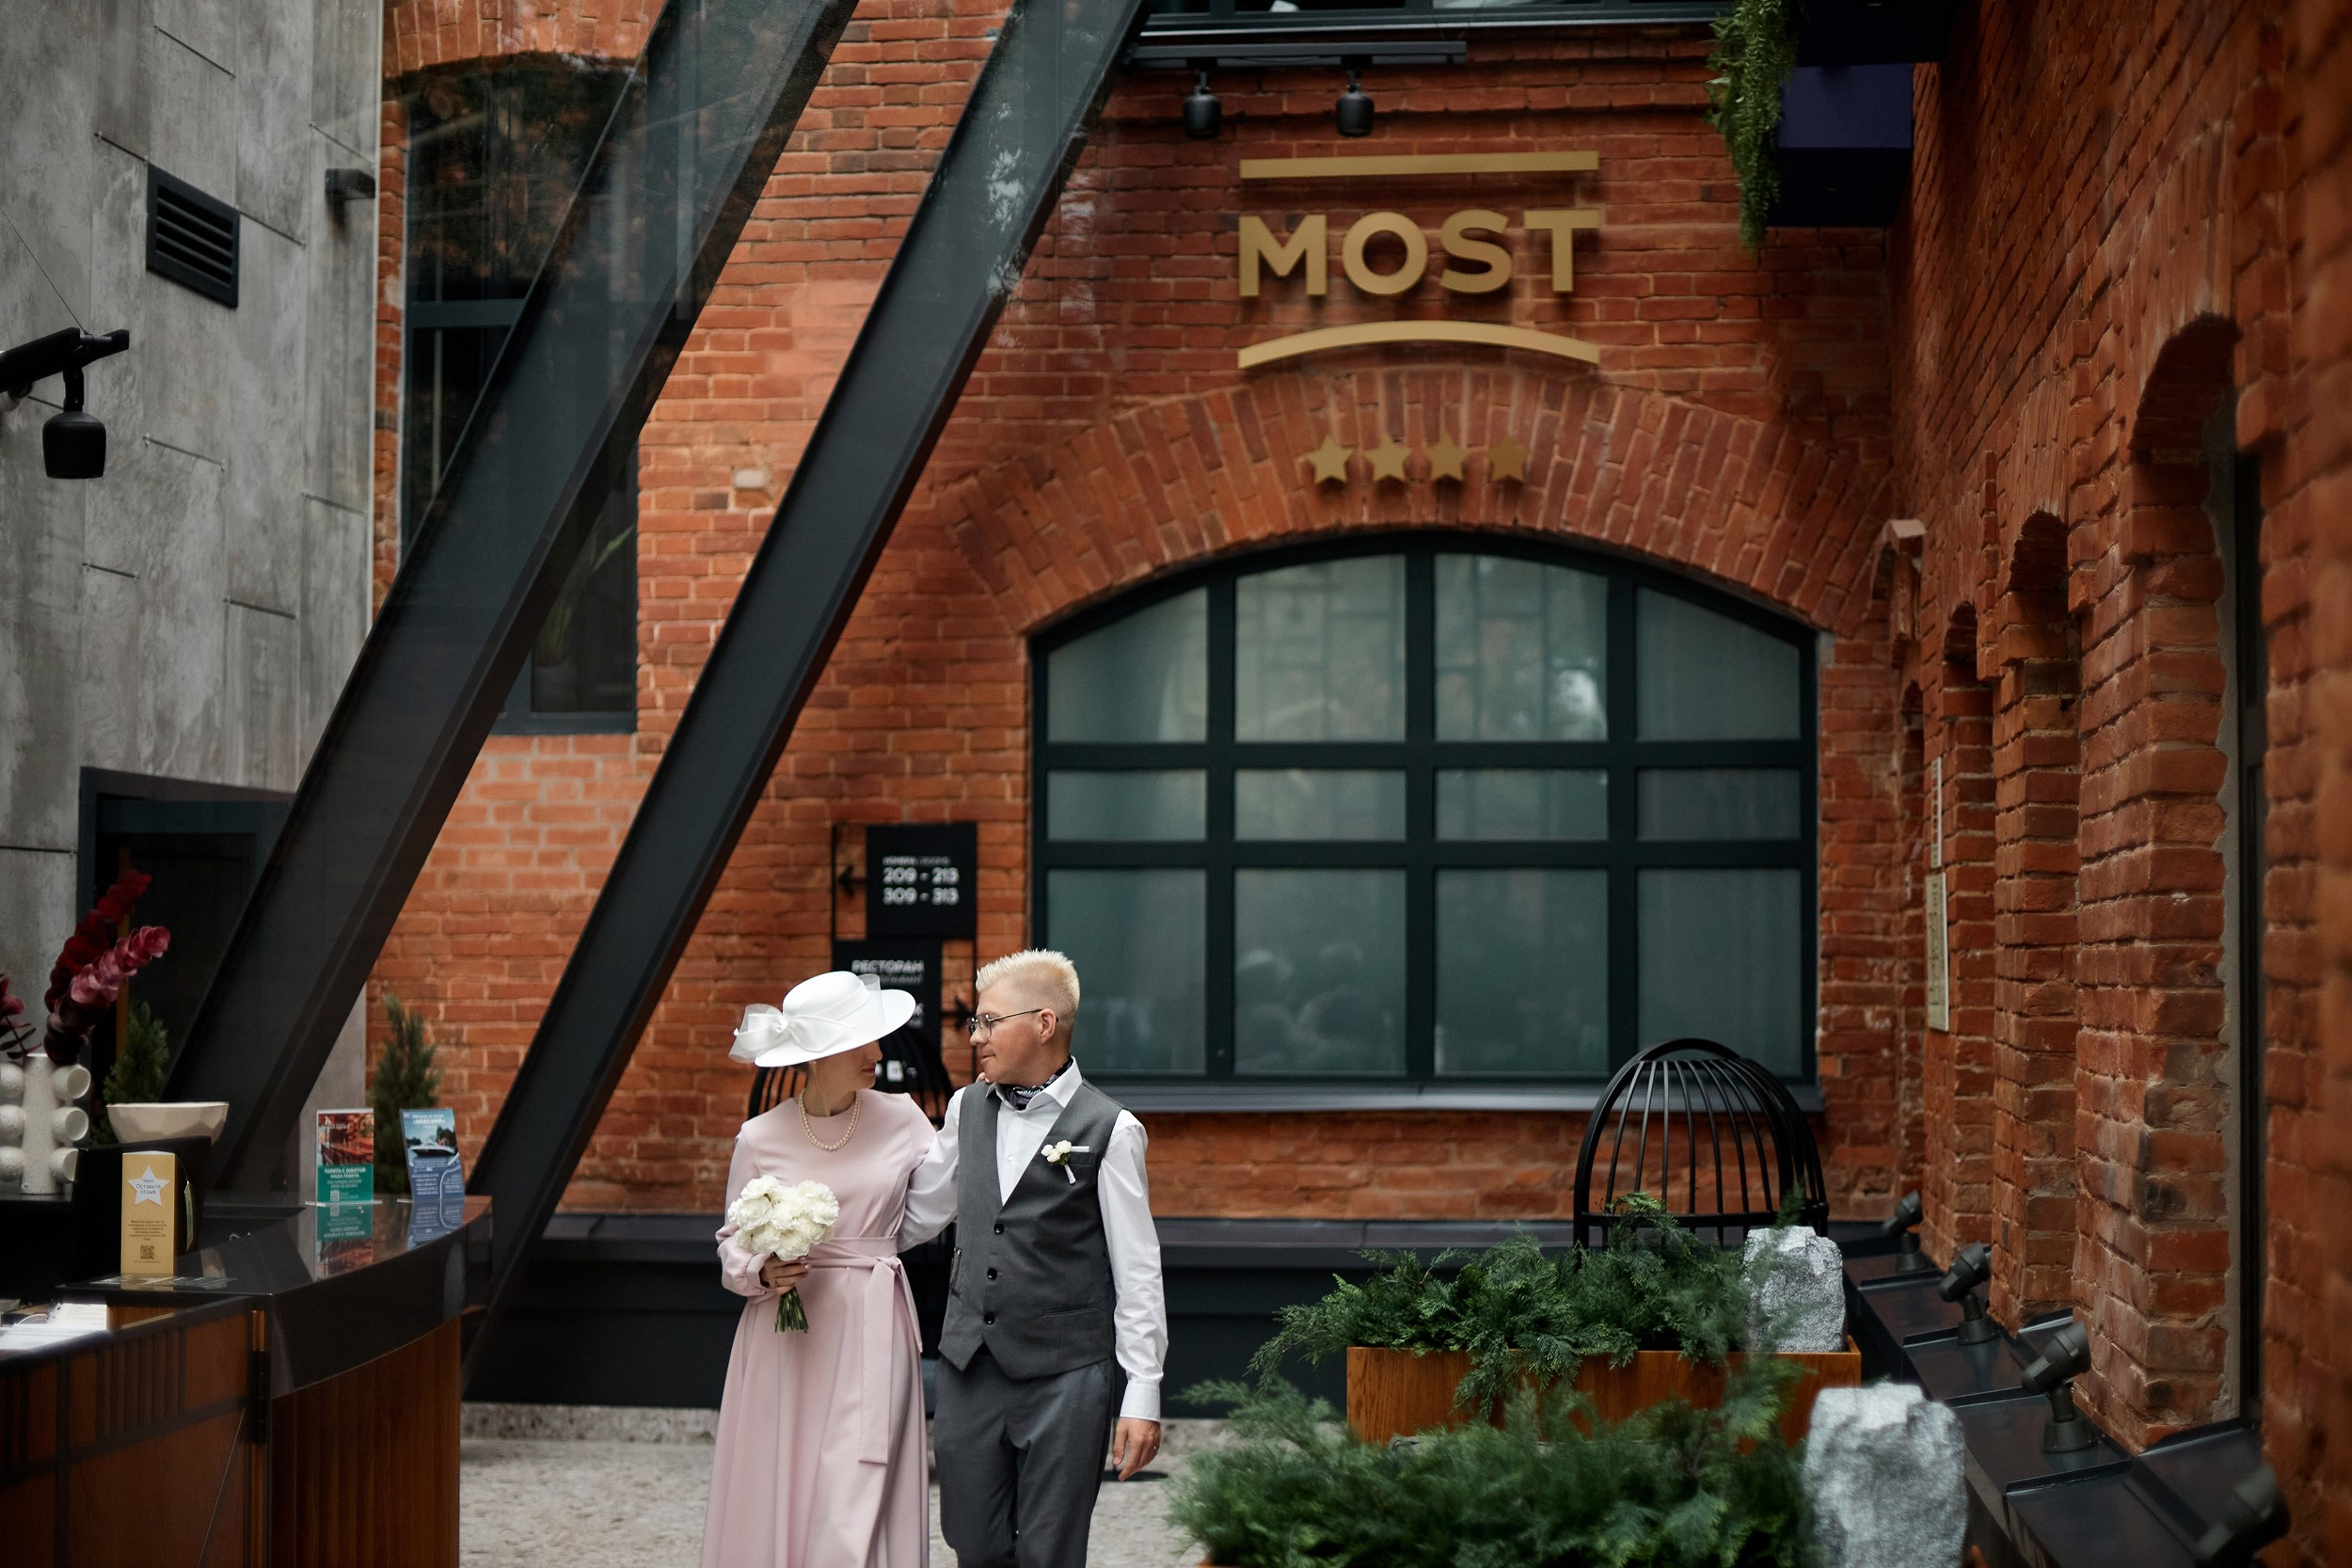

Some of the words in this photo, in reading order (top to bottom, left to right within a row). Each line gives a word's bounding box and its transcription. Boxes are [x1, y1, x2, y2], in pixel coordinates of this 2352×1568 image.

[1239, 209, 1599, 296] MOST
[882, 867, 917, 885] 209
[931, 867, 959, 885] 213
[882, 887, 917, 905] 309
[931, 887, 959, 905] 313
[851, 959, 924, 974] РЕСТОРАН
